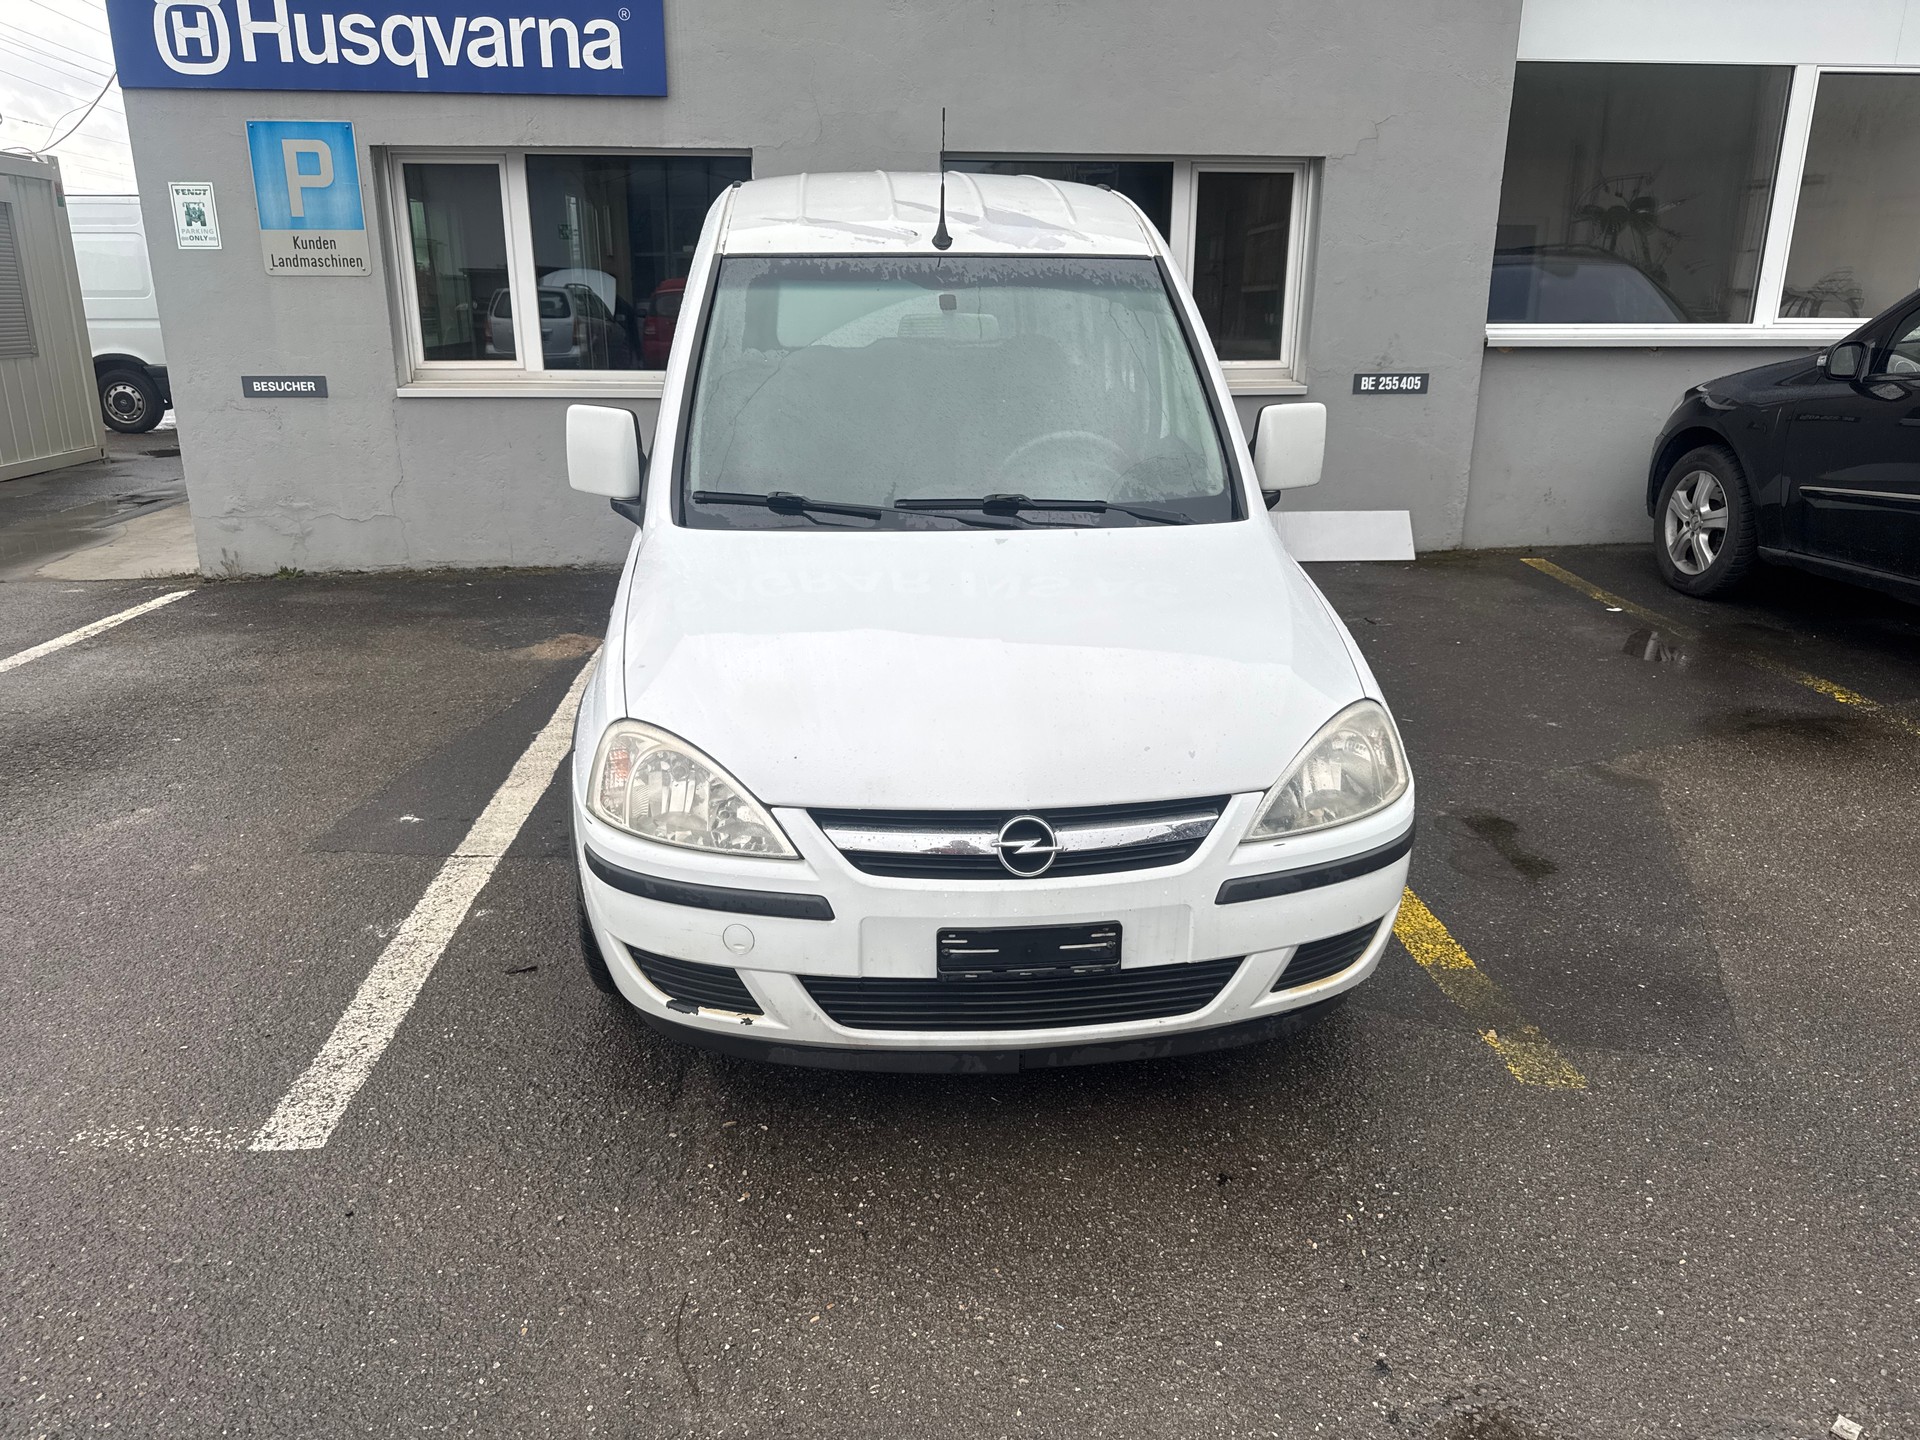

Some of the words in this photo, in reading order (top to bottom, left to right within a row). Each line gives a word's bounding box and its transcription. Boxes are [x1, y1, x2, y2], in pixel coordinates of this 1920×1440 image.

[281, 139, 334, 217] P
[174, 188, 209, 196] FENDT
[292, 236, 337, 250] Kunden
[270, 253, 363, 268] Landmaschinen
[252, 381, 316, 392] BESUCHER
[1360, 376, 1376, 390] BE
